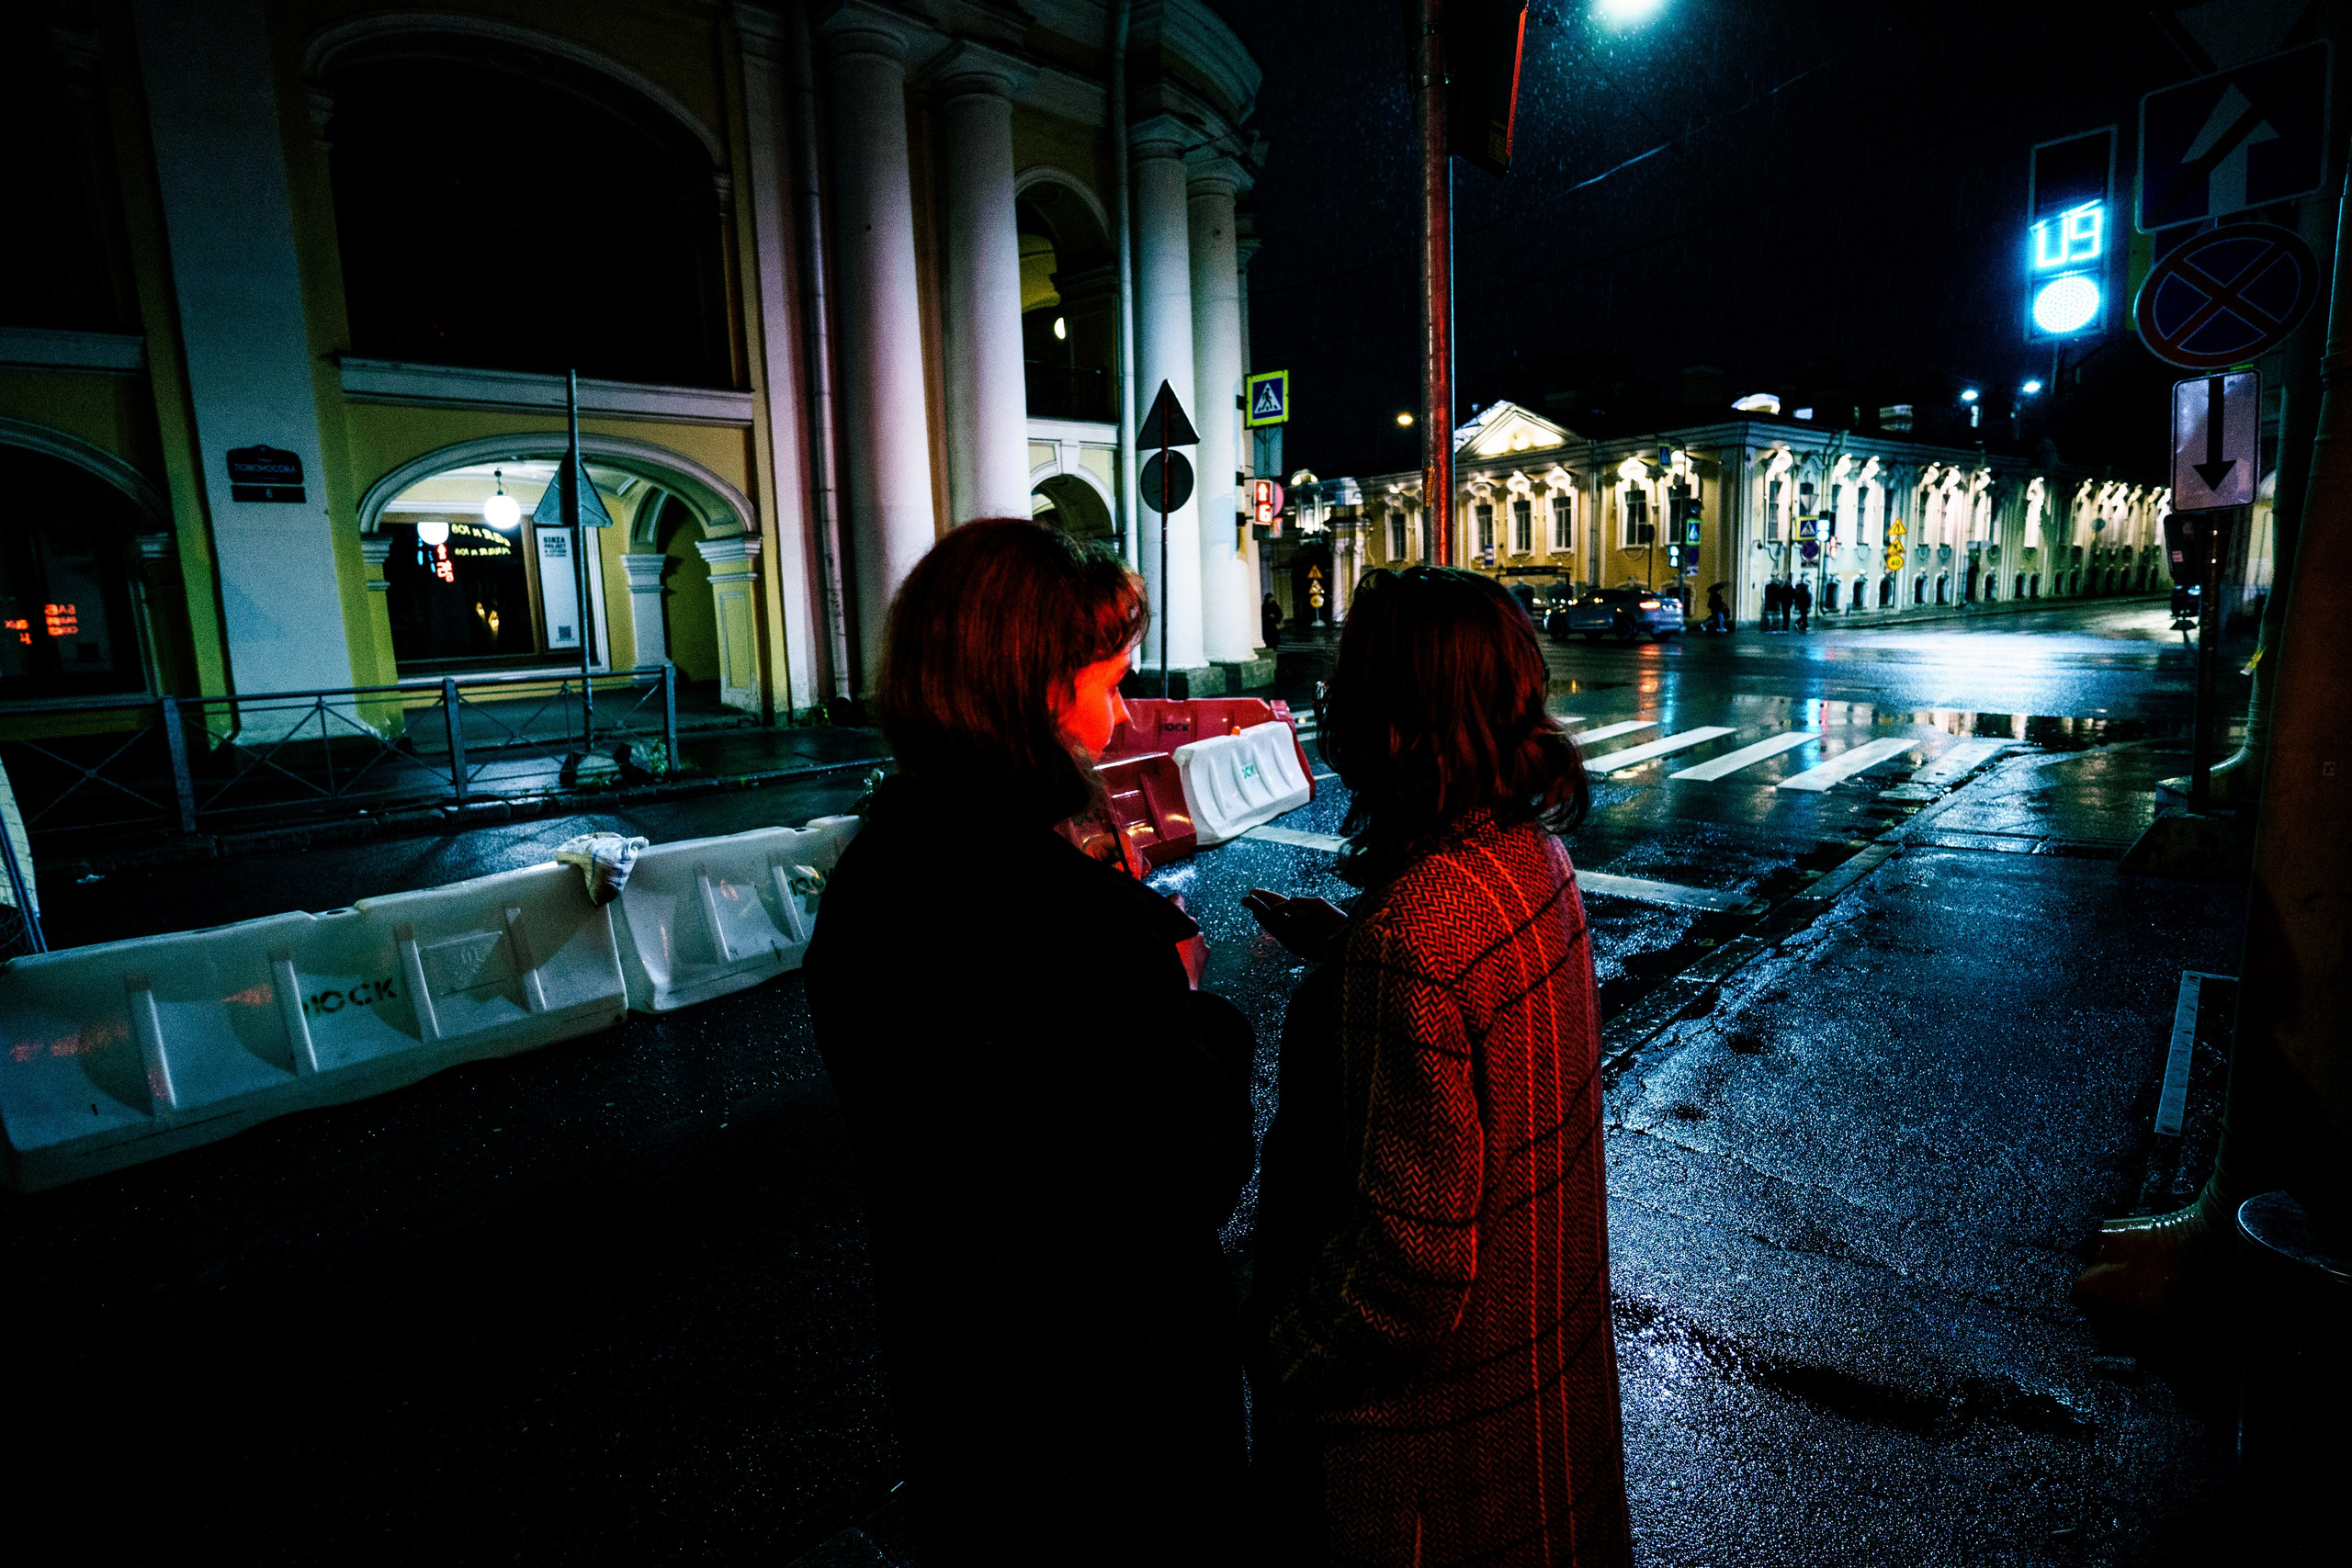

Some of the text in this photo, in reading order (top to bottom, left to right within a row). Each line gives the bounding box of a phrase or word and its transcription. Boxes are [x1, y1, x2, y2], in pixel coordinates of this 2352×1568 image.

[266, 488, 274, 499] 6
[1259, 504, 1272, 523] 6
[1891, 558, 1901, 567] 40
